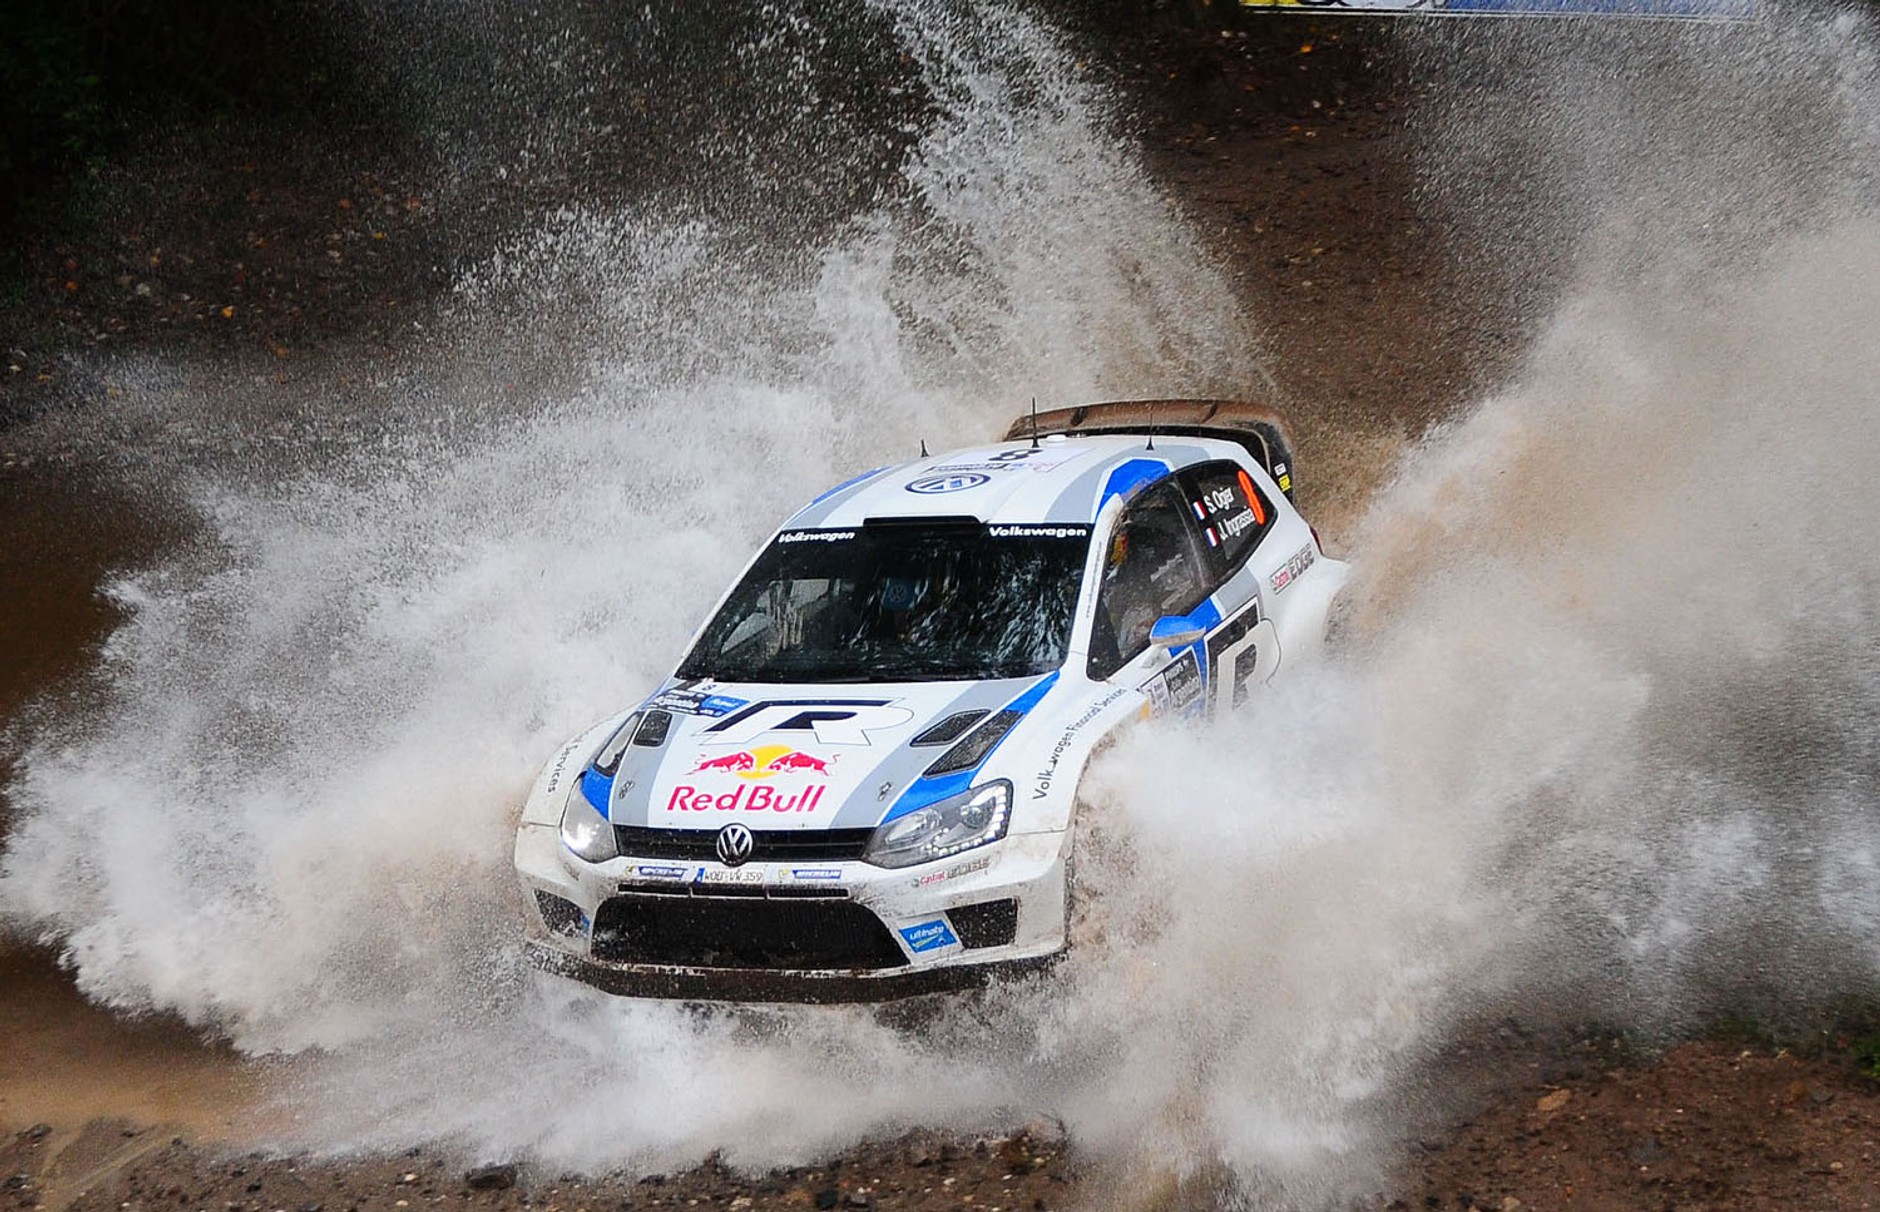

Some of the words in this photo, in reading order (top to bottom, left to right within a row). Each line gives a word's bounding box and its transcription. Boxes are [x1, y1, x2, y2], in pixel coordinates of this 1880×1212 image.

[1203, 495, 1217, 514] S.
[1212, 487, 1235, 510] Ogier
[778, 531, 856, 543] Volkswagen
[989, 525, 1087, 538] Volkswagen
[698, 697, 914, 746] R
[1032, 731, 1075, 800] Volkwagen
[1066, 704, 1102, 732] Financial
[667, 784, 746, 812] Red
[744, 784, 827, 813] Bull
